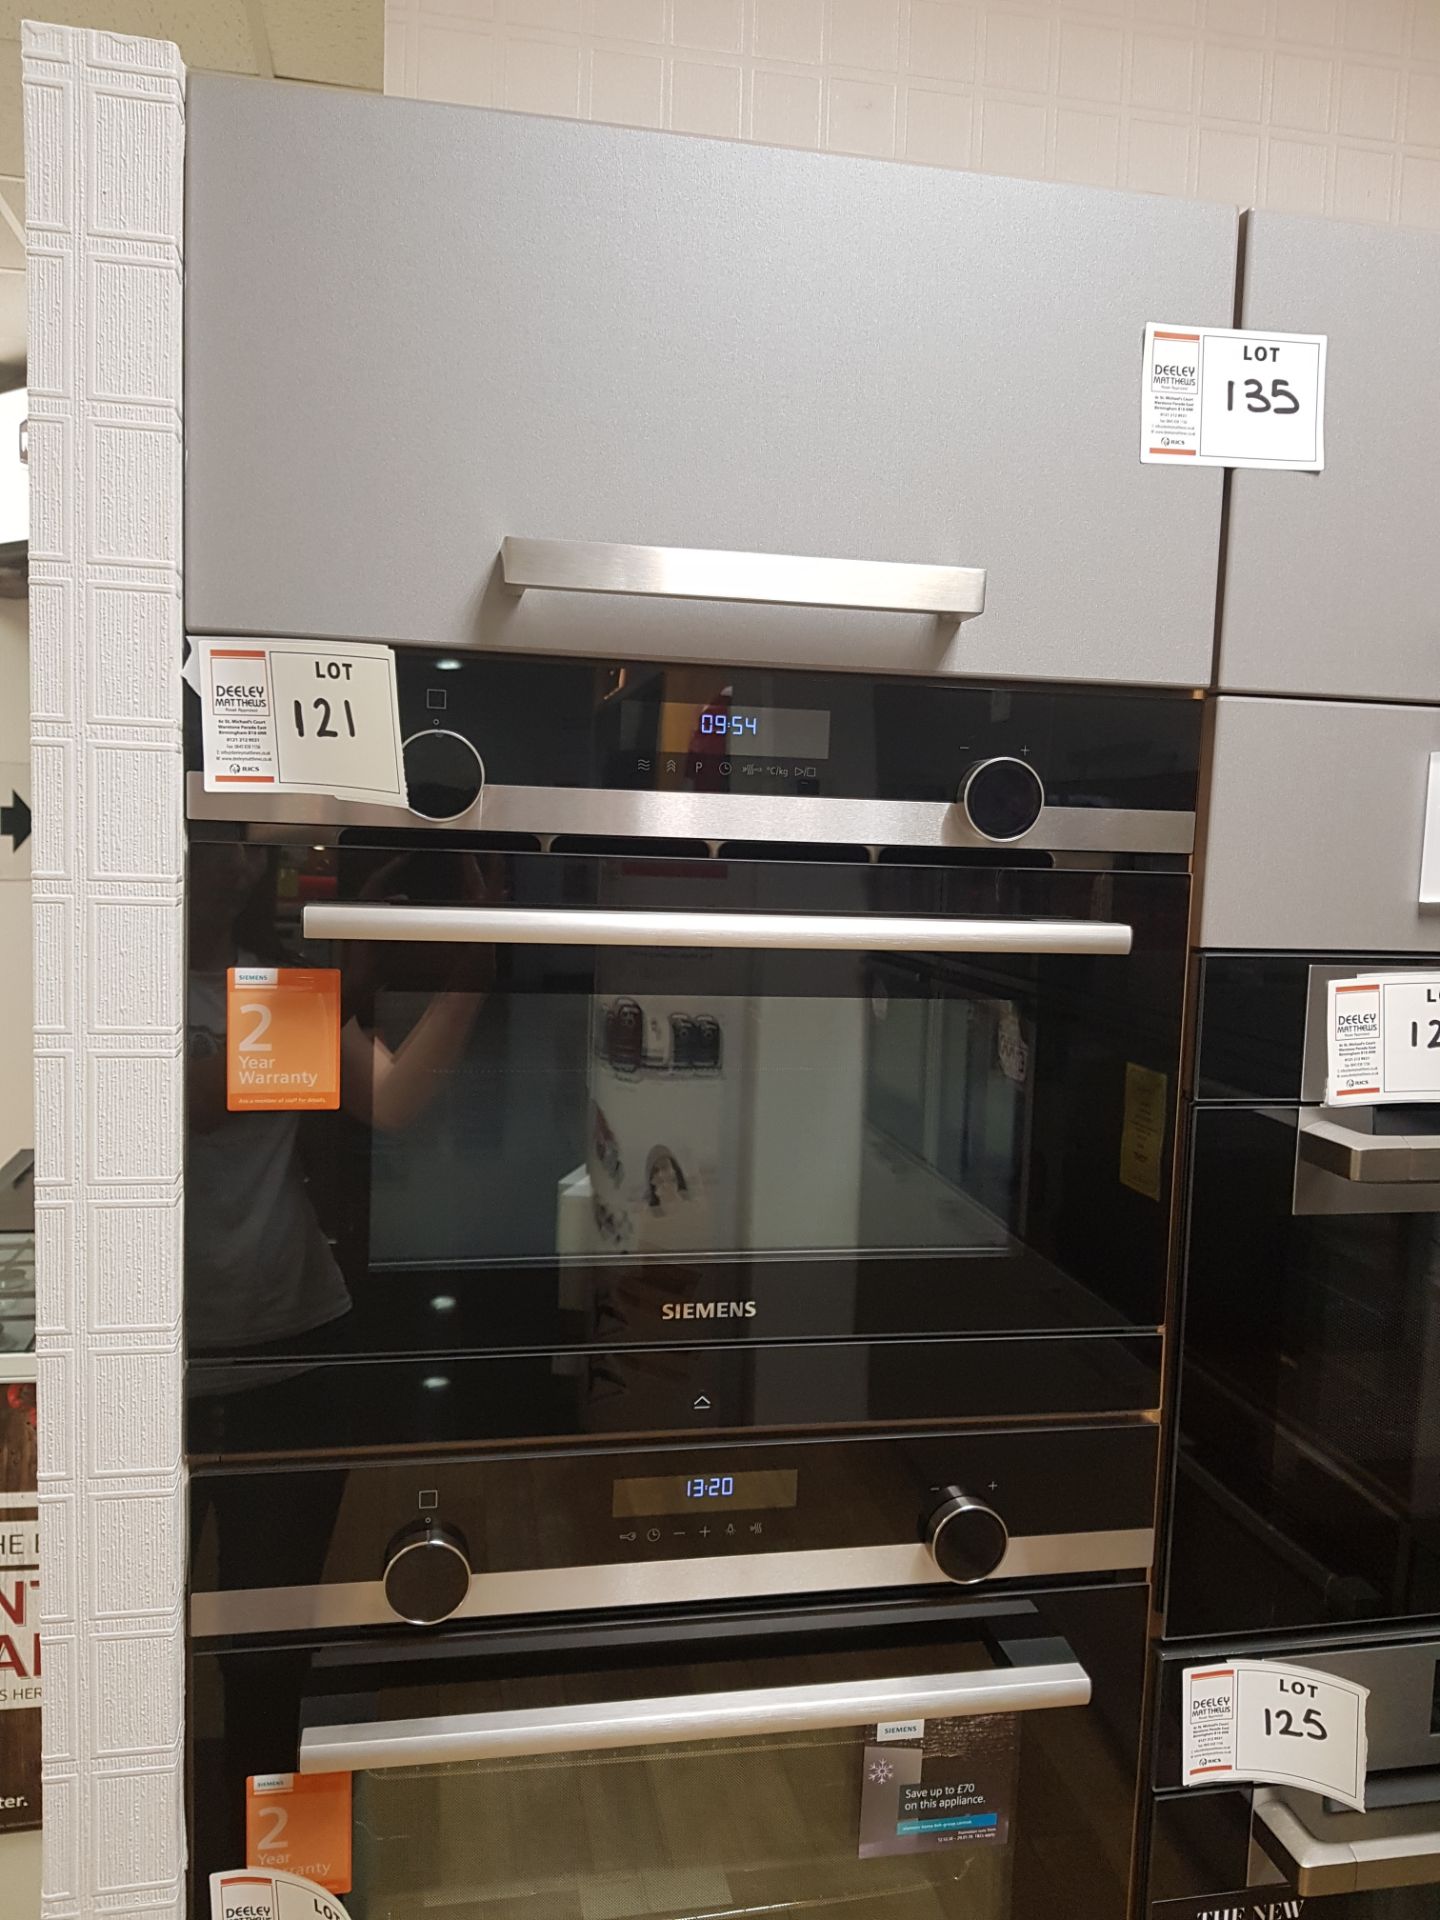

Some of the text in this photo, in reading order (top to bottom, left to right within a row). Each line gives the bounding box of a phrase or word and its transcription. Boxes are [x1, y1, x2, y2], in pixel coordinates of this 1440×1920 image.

[1243, 344, 1280, 362] LOT
[1154, 364, 1195, 377] DEELEY
[1153, 376, 1196, 386] MATTHEWS
[1227, 378, 1300, 414] 135
[315, 661, 353, 680] LOT
[216, 685, 264, 698] DEELEY
[215, 698, 267, 708] MATTHEWS
[294, 697, 355, 737] 121
[701, 714, 757, 735] 09:54
[1426, 988, 1440, 1002] L
[1338, 1013, 1376, 1025] DEELEY
[239, 1003, 273, 1052] 2
[1337, 1024, 1377, 1033] MATTHEWS
[238, 1056, 275, 1069] Year
[239, 1072, 319, 1087] Warranty
[662, 1301, 757, 1320] SIEMENS
[687, 1477, 733, 1497] 13:20
[1279, 1679, 1318, 1698] LOT
[1193, 1697, 1230, 1709] DEELEY
[1192, 1706, 1231, 1717] MATTHEWS
[884, 1725, 917, 1734] SIEMENS
[1265, 1708, 1328, 1740] 125
[905, 1783, 975, 1799] Save up to £70
[905, 1795, 986, 1811] on this appliance.
[257, 1806, 289, 1850] 2
[257, 1853, 291, 1866] Year
[226, 1906, 270, 1918] DEELEY
[1253, 1900, 1304, 1920] NEW
